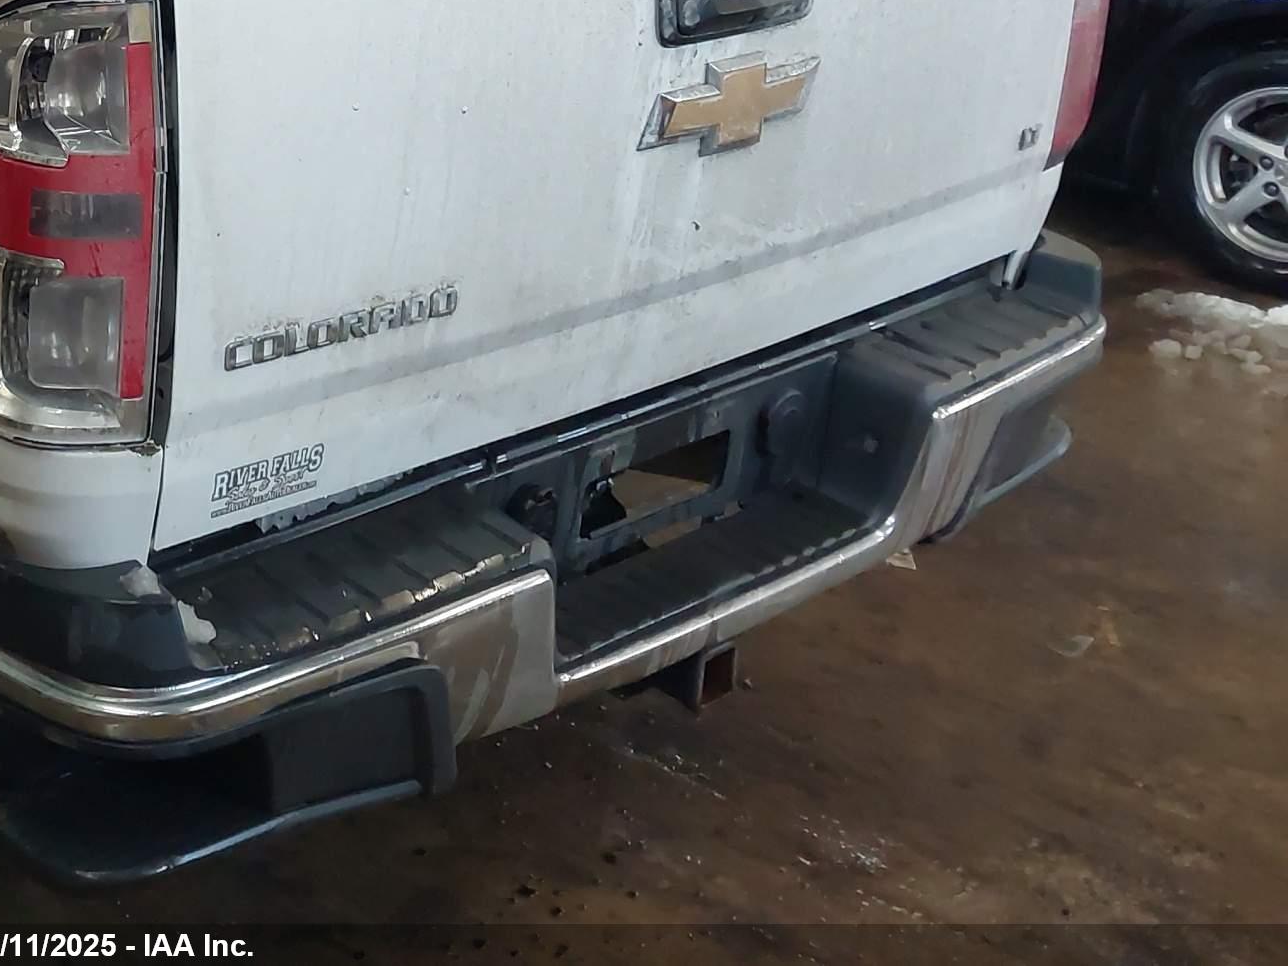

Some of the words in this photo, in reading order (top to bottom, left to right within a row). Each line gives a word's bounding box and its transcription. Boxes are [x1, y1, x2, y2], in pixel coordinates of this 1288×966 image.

[224, 284, 459, 371] COLORADO
[211, 459, 269, 502] RIVER
[270, 443, 325, 477] FALLS
